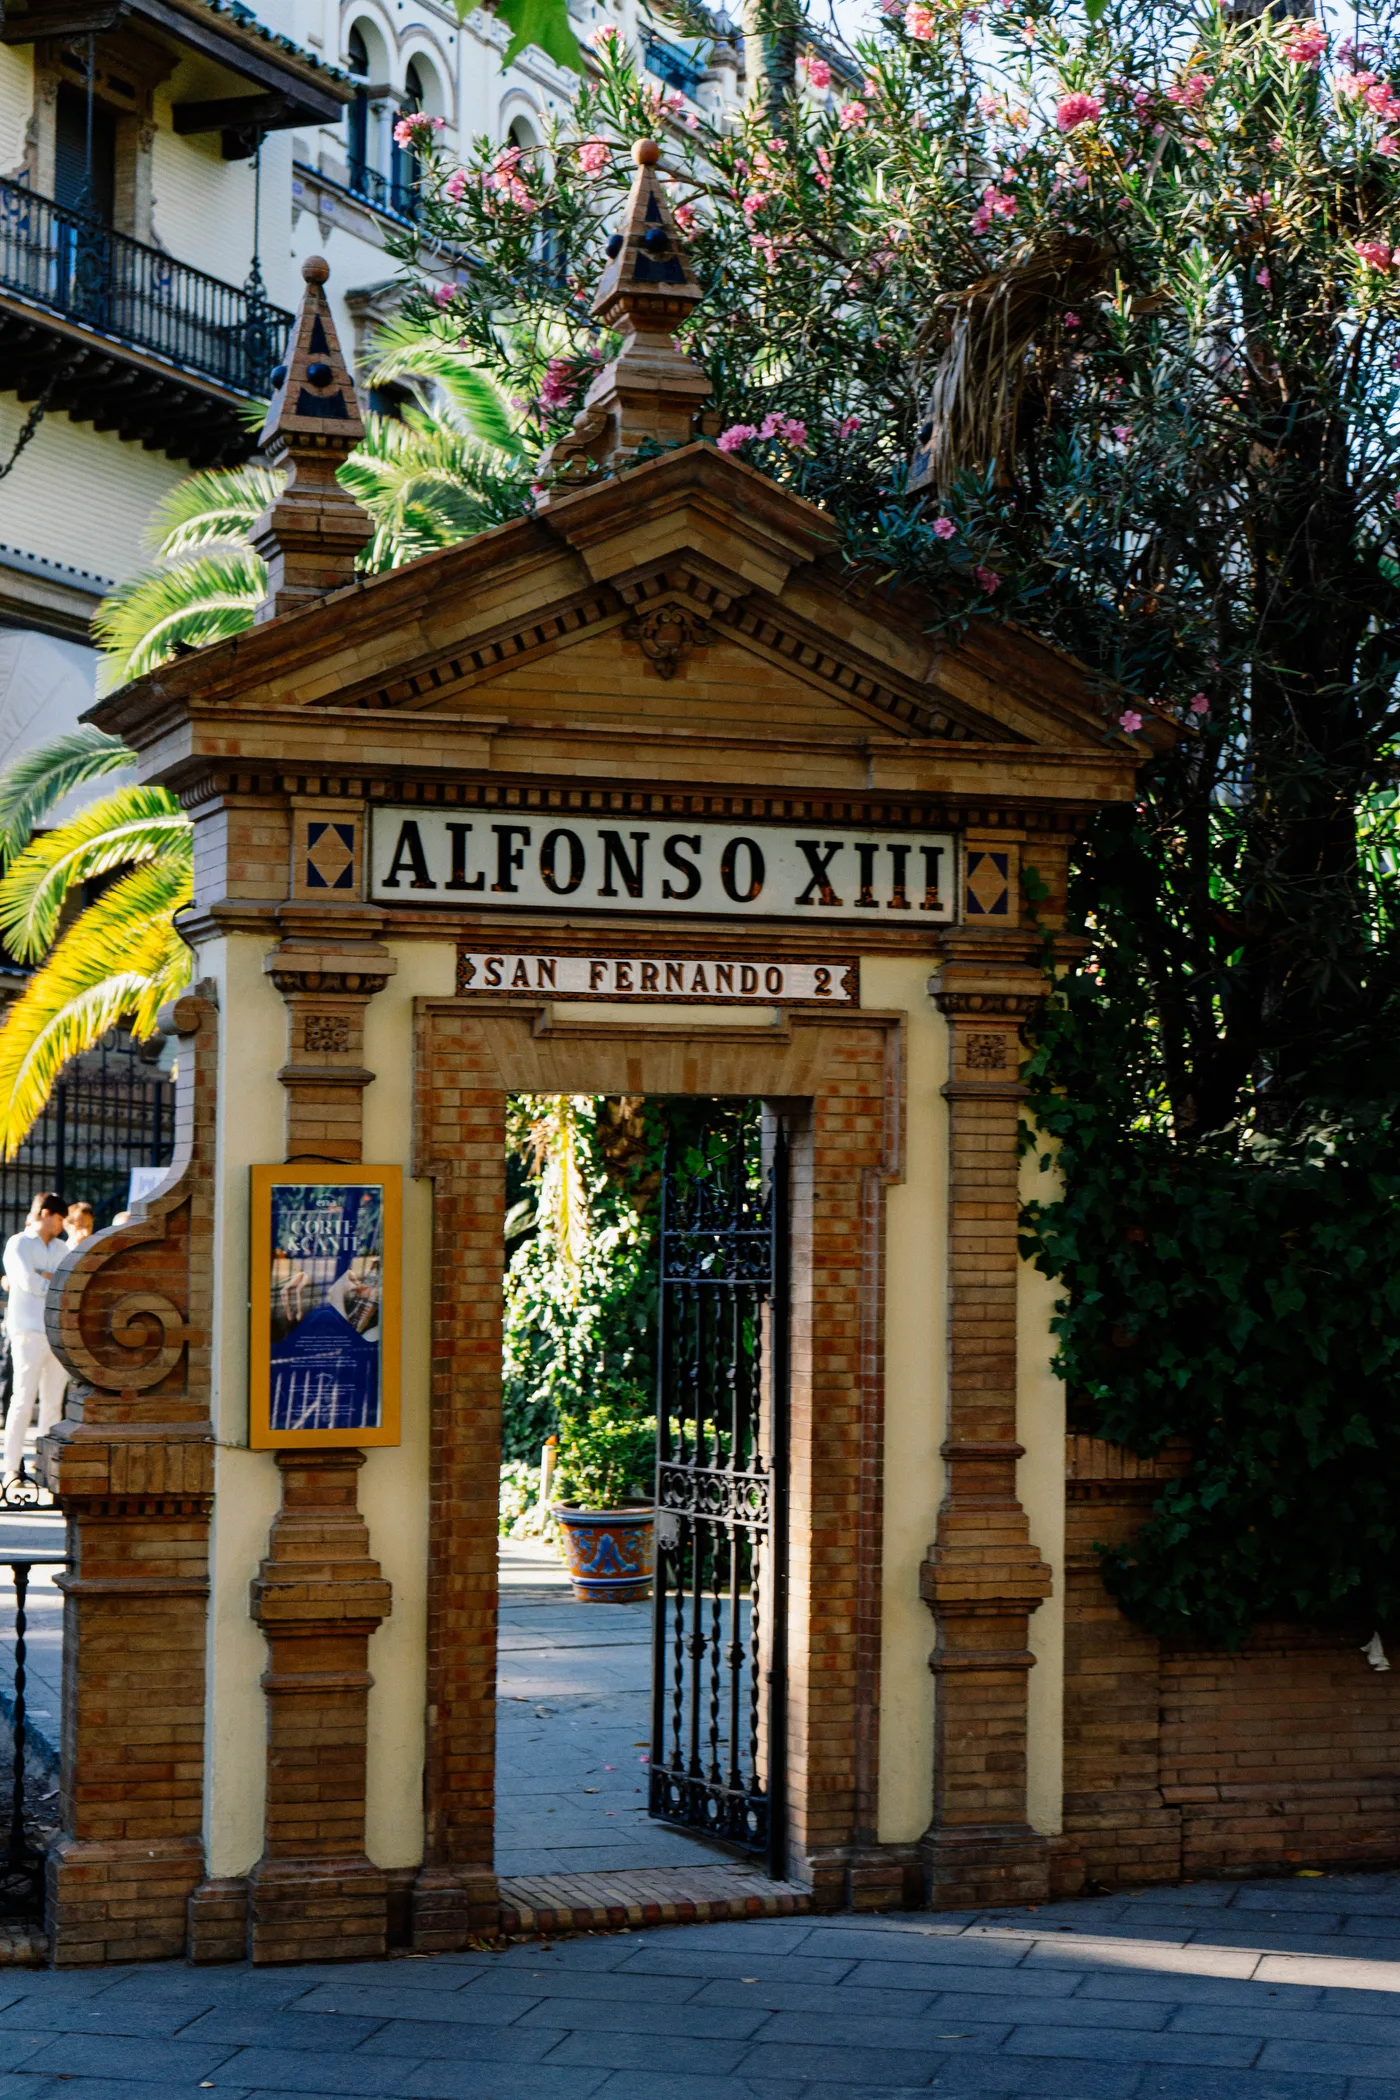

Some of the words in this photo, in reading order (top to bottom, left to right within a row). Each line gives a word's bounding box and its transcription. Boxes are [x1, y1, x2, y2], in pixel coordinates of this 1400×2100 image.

[382, 820, 765, 903] ALFONSO
[795, 840, 945, 911] XIII
[484, 957, 557, 989] SAN
[588, 960, 784, 995] FERNANDO
[814, 967, 832, 997] 2
